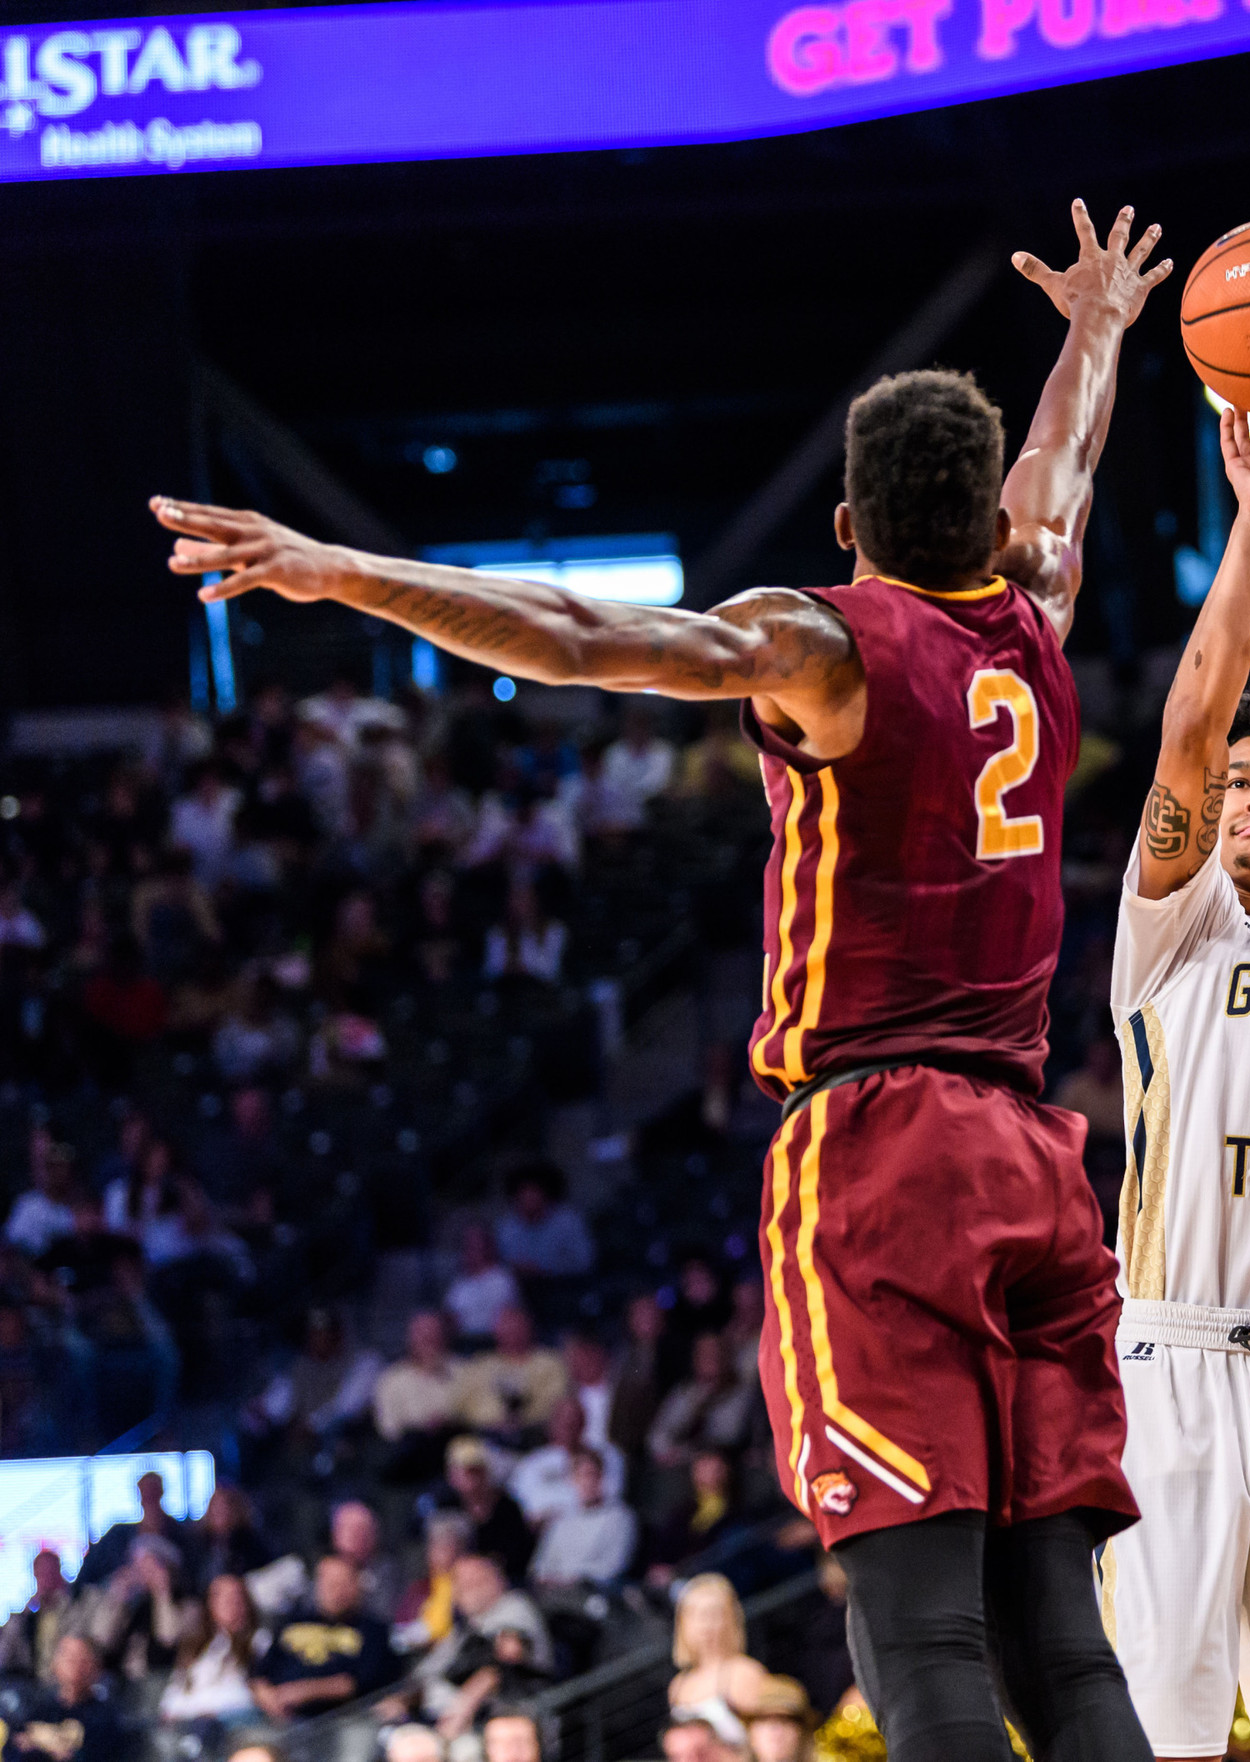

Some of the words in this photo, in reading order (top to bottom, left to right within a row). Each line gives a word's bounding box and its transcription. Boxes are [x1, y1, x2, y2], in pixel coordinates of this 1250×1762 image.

[0, 24, 262, 118] LSTAR
[767, 0, 949, 96] GET
[966, 667, 1044, 861] 2
